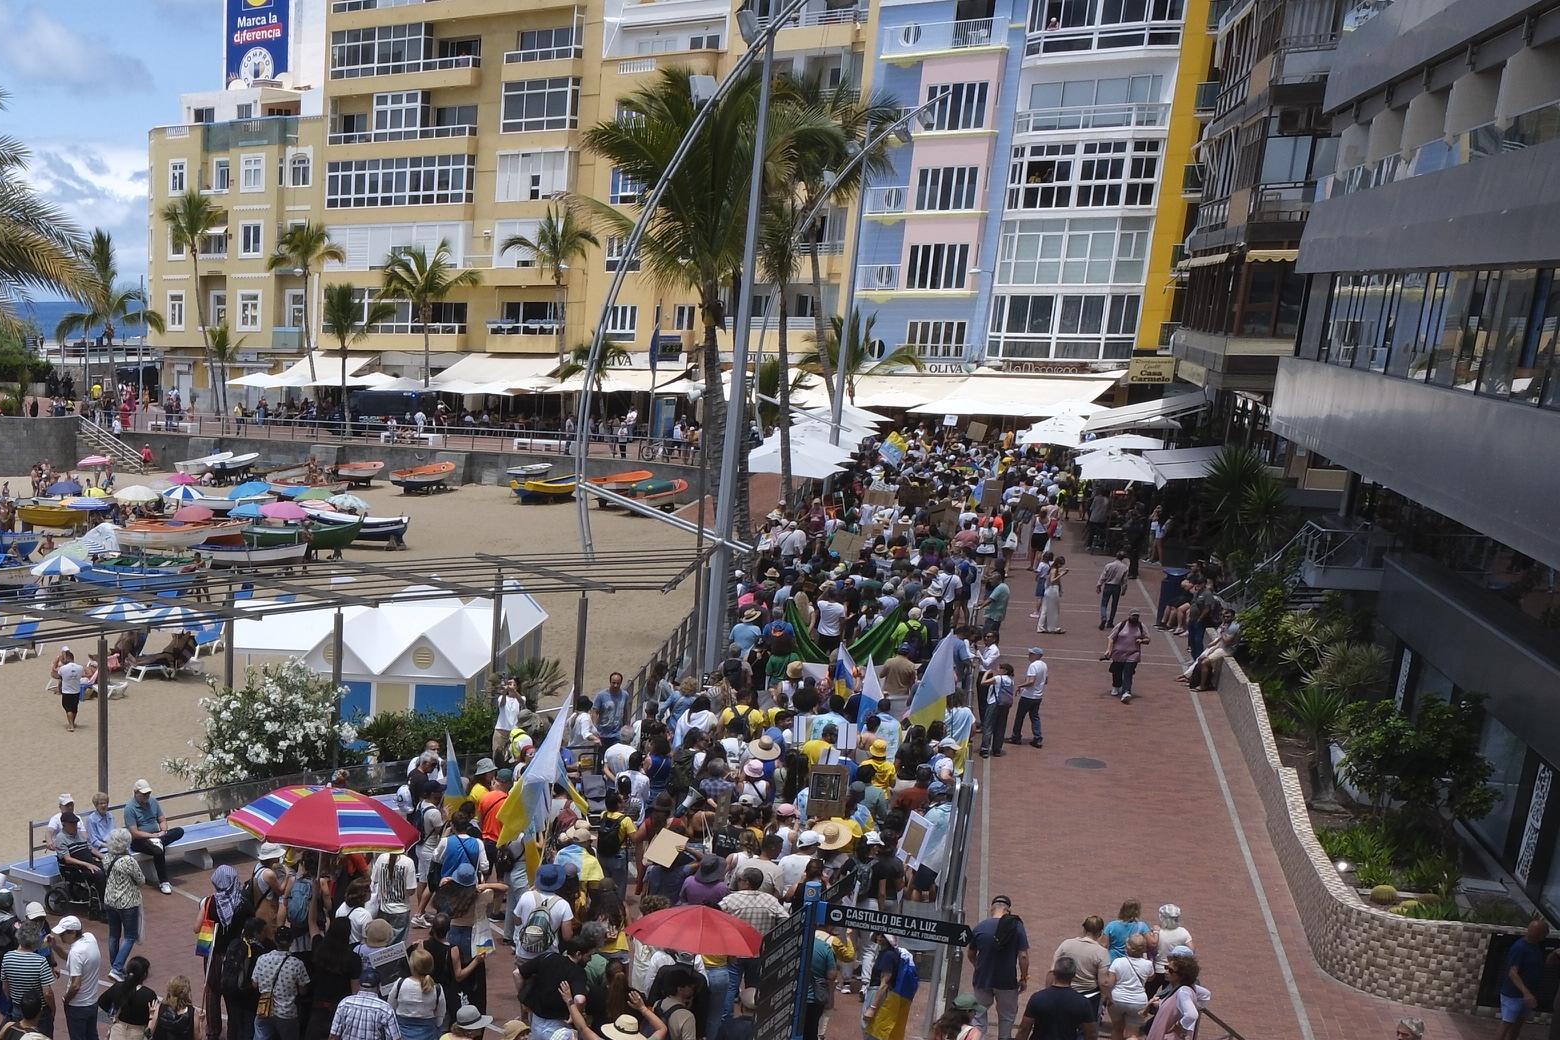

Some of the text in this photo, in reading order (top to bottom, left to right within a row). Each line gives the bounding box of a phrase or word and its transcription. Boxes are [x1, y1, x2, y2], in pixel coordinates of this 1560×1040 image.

[237, 12, 278, 28] Marca la
[233, 28, 282, 44] diferencia
[929, 363, 964, 374] OLIVA
[1140, 369, 1163, 377] Casa
[1130, 375, 1171, 383] Carmelo
[846, 908, 938, 933] CASTILLO DE LA LUZ
